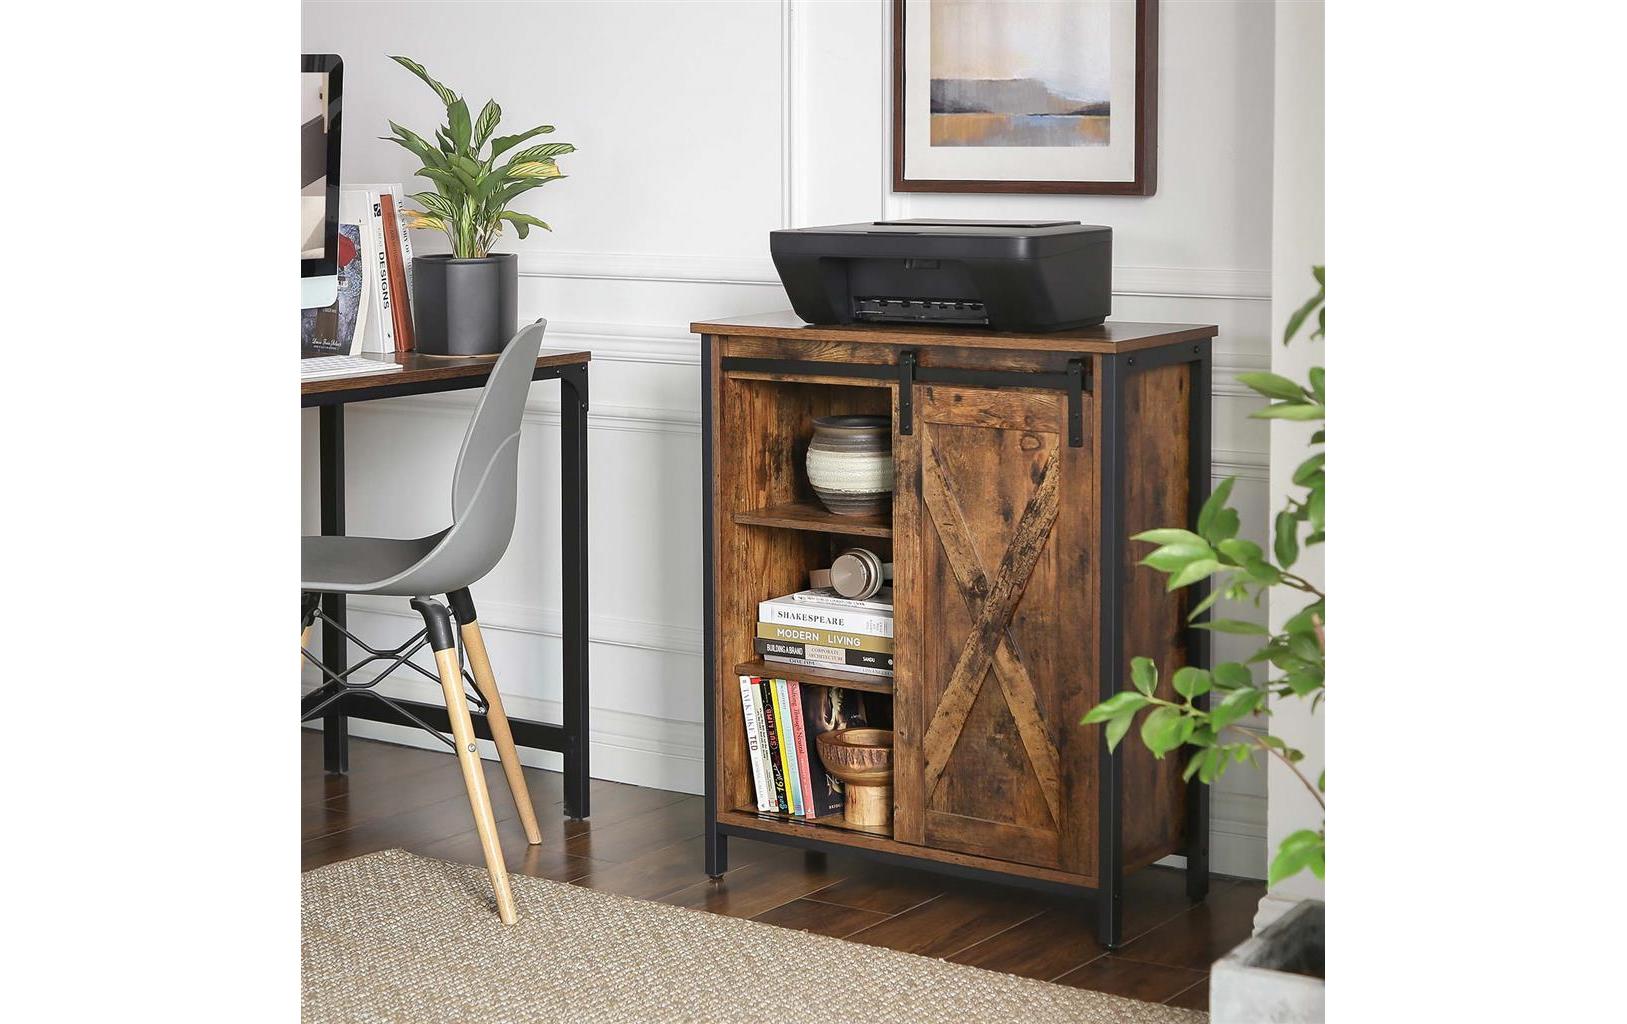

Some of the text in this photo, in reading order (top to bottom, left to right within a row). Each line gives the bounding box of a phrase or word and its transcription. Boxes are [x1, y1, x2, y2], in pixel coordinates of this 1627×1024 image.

[378, 252, 389, 309] DESIGNS
[777, 610, 844, 626] SHAKESPEARE
[777, 628, 860, 646] MODERN LIVING
[766, 644, 786, 653] BUILDING
[789, 646, 803, 655] BRAND
[750, 735, 758, 750] TED
